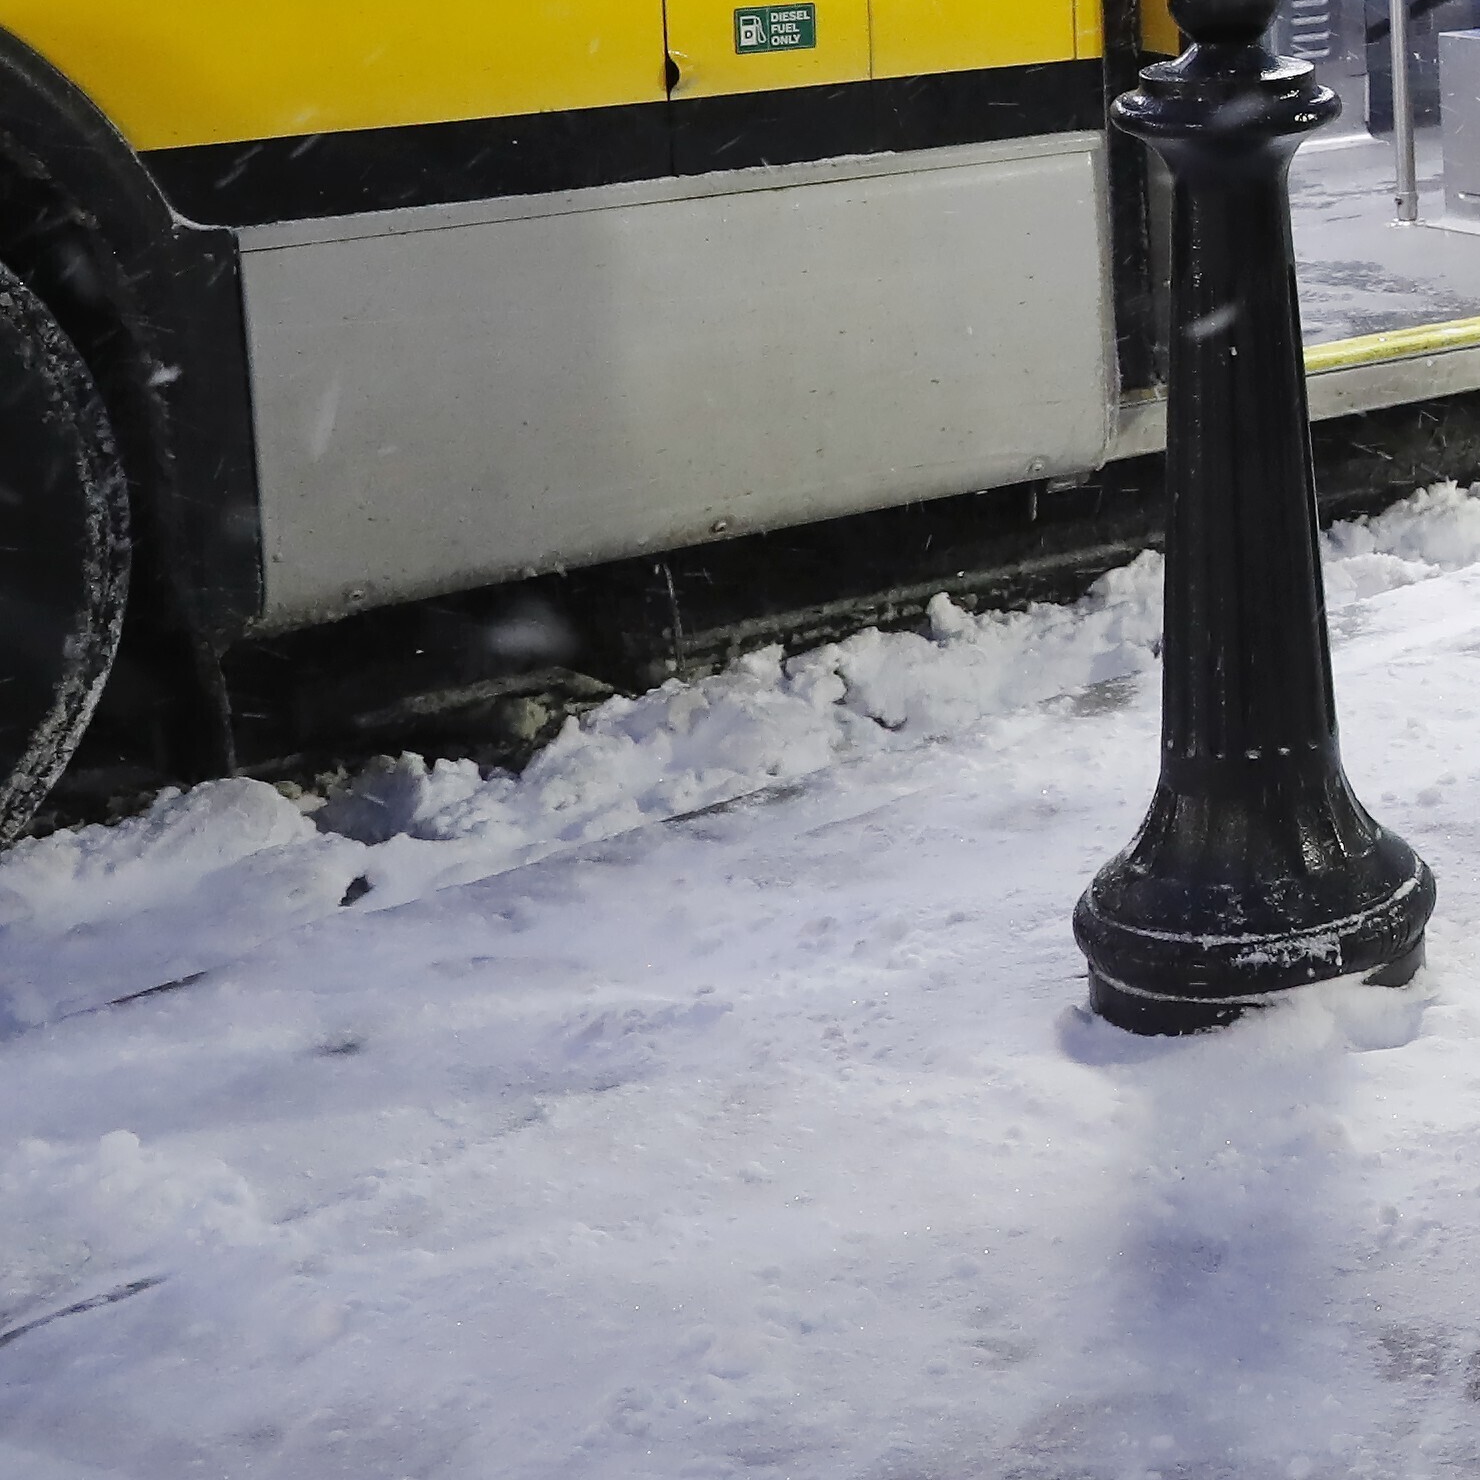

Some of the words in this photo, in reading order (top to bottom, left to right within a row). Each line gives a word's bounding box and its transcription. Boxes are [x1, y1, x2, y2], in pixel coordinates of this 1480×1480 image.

[770, 10, 811, 23] DIESEL
[771, 23, 800, 34] FUEL
[771, 34, 801, 46] ONLY
